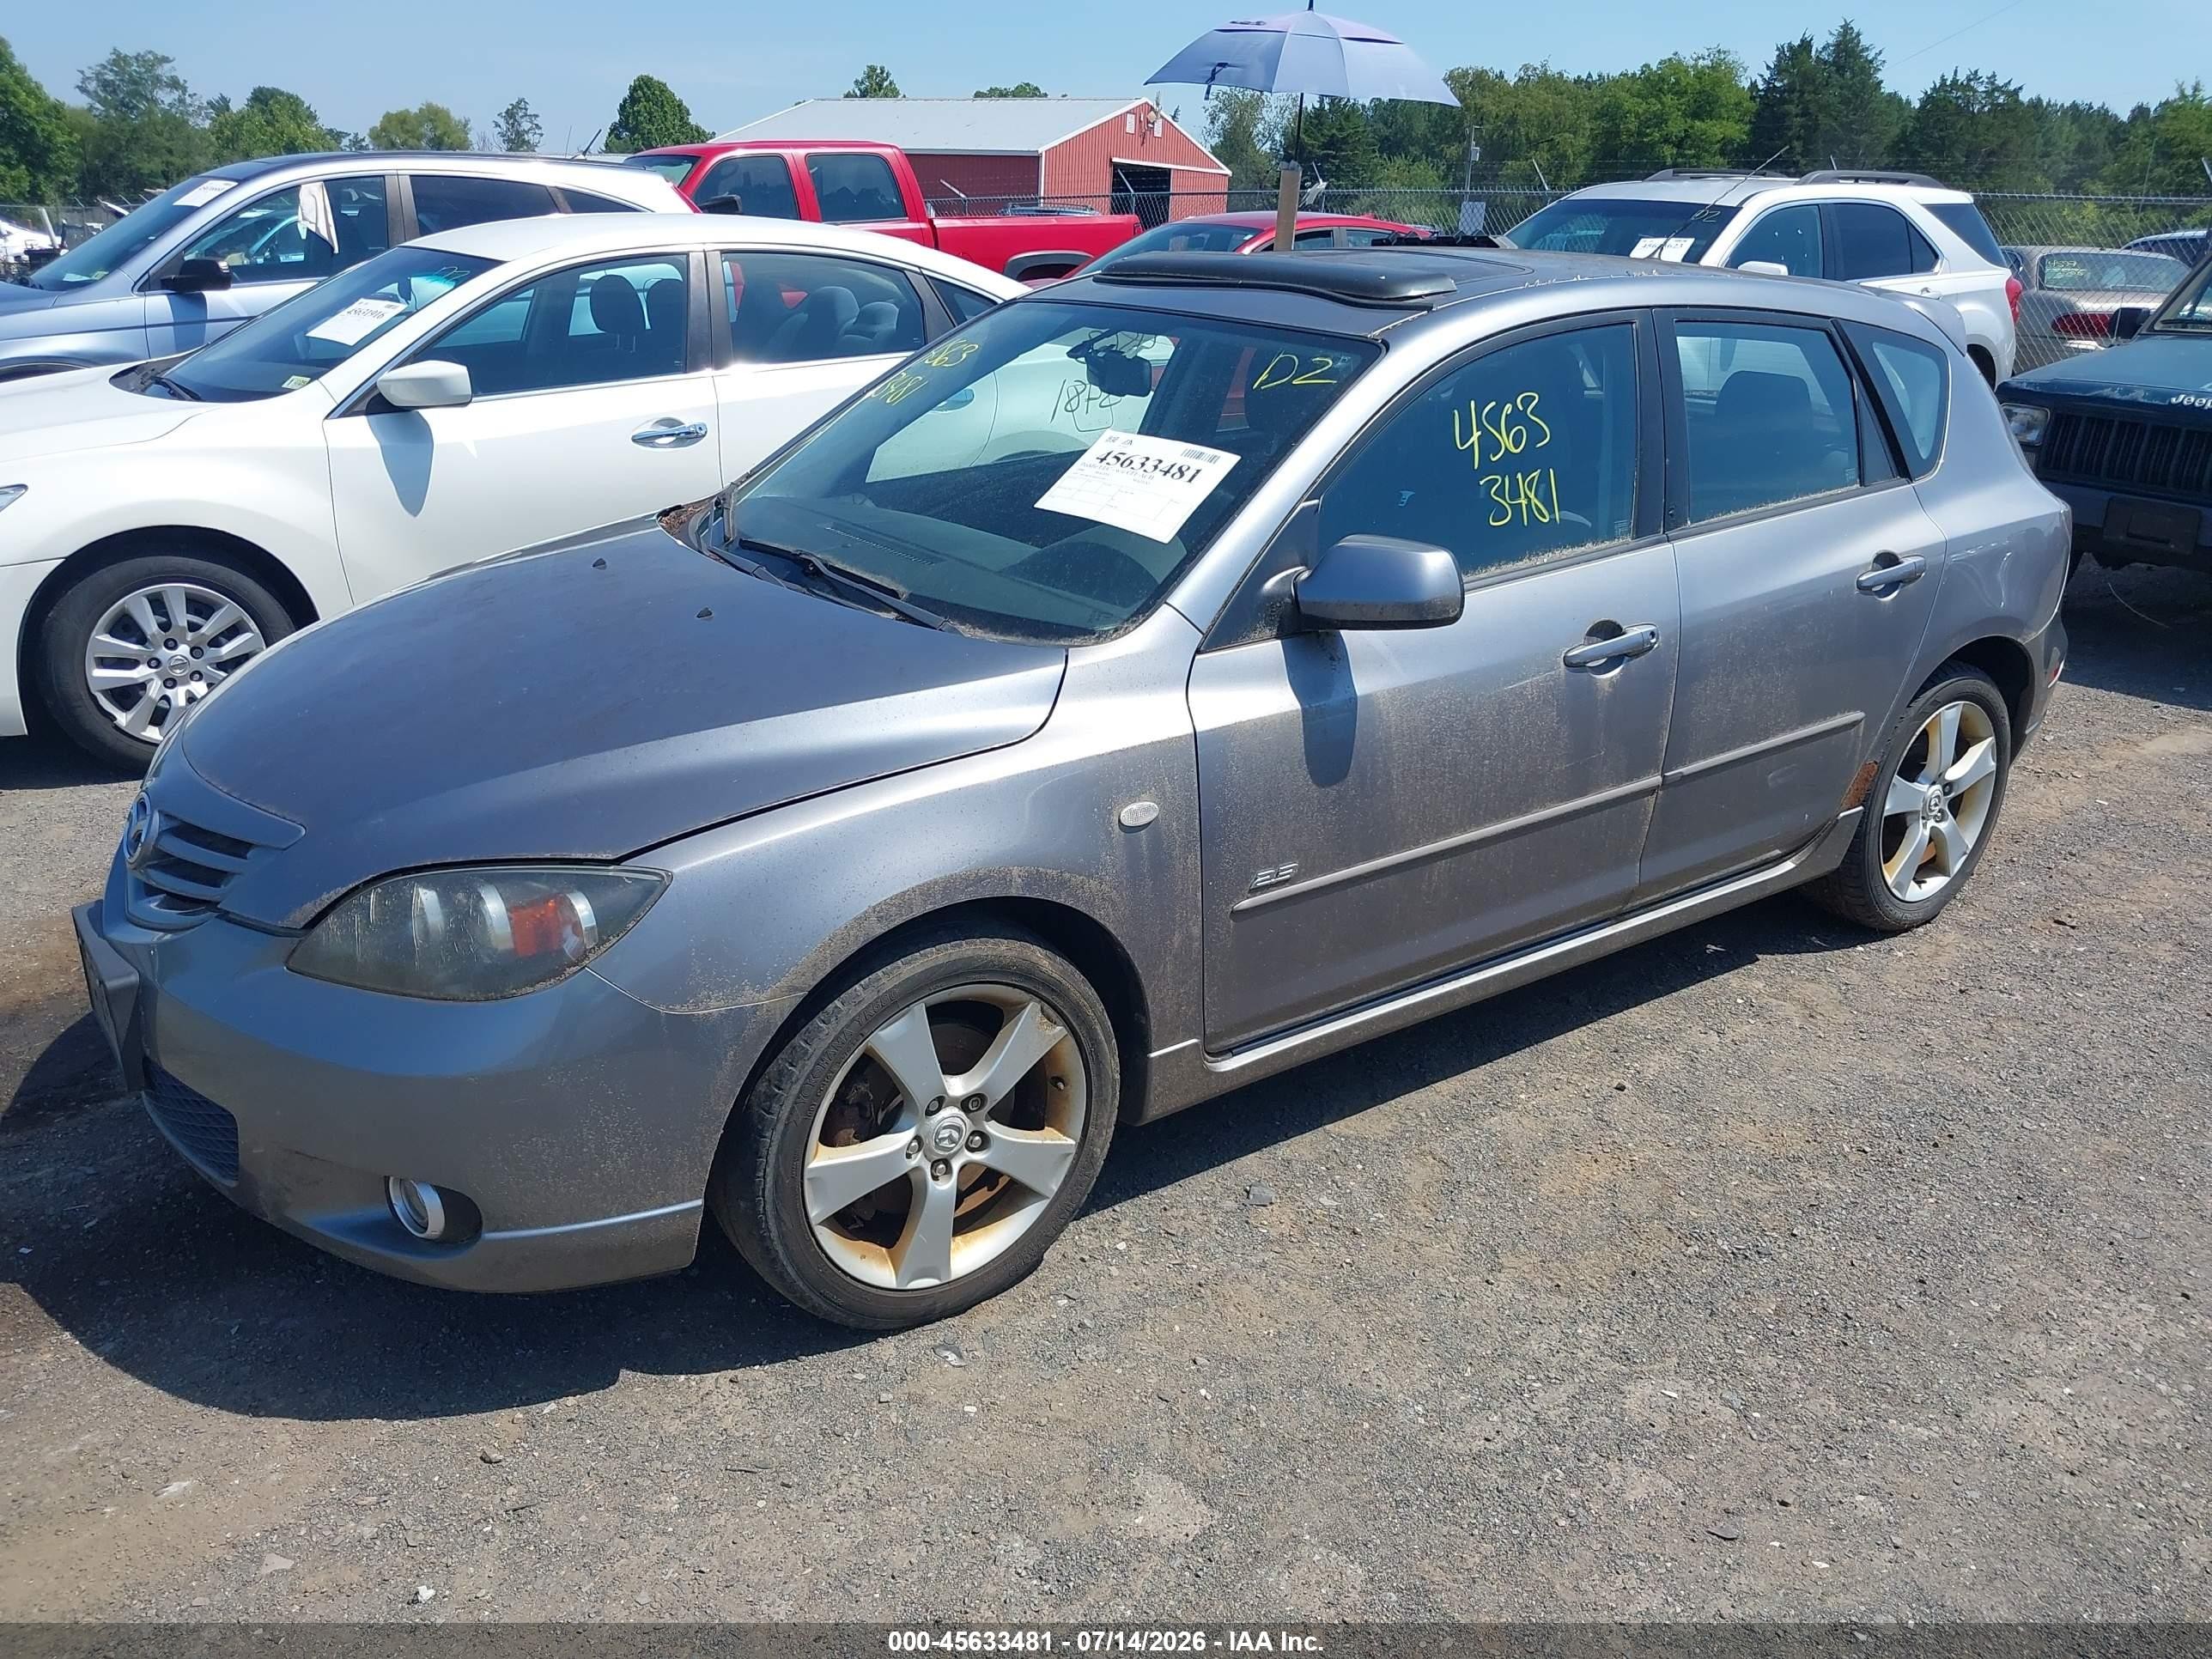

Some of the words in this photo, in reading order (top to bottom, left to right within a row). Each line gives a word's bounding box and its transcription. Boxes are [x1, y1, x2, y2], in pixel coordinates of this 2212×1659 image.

[1252, 349, 1338, 390] D2
[1453, 392, 1551, 470] 4563
[1096, 450, 1202, 483] 45633481
[1479, 468, 1560, 526] 3481
